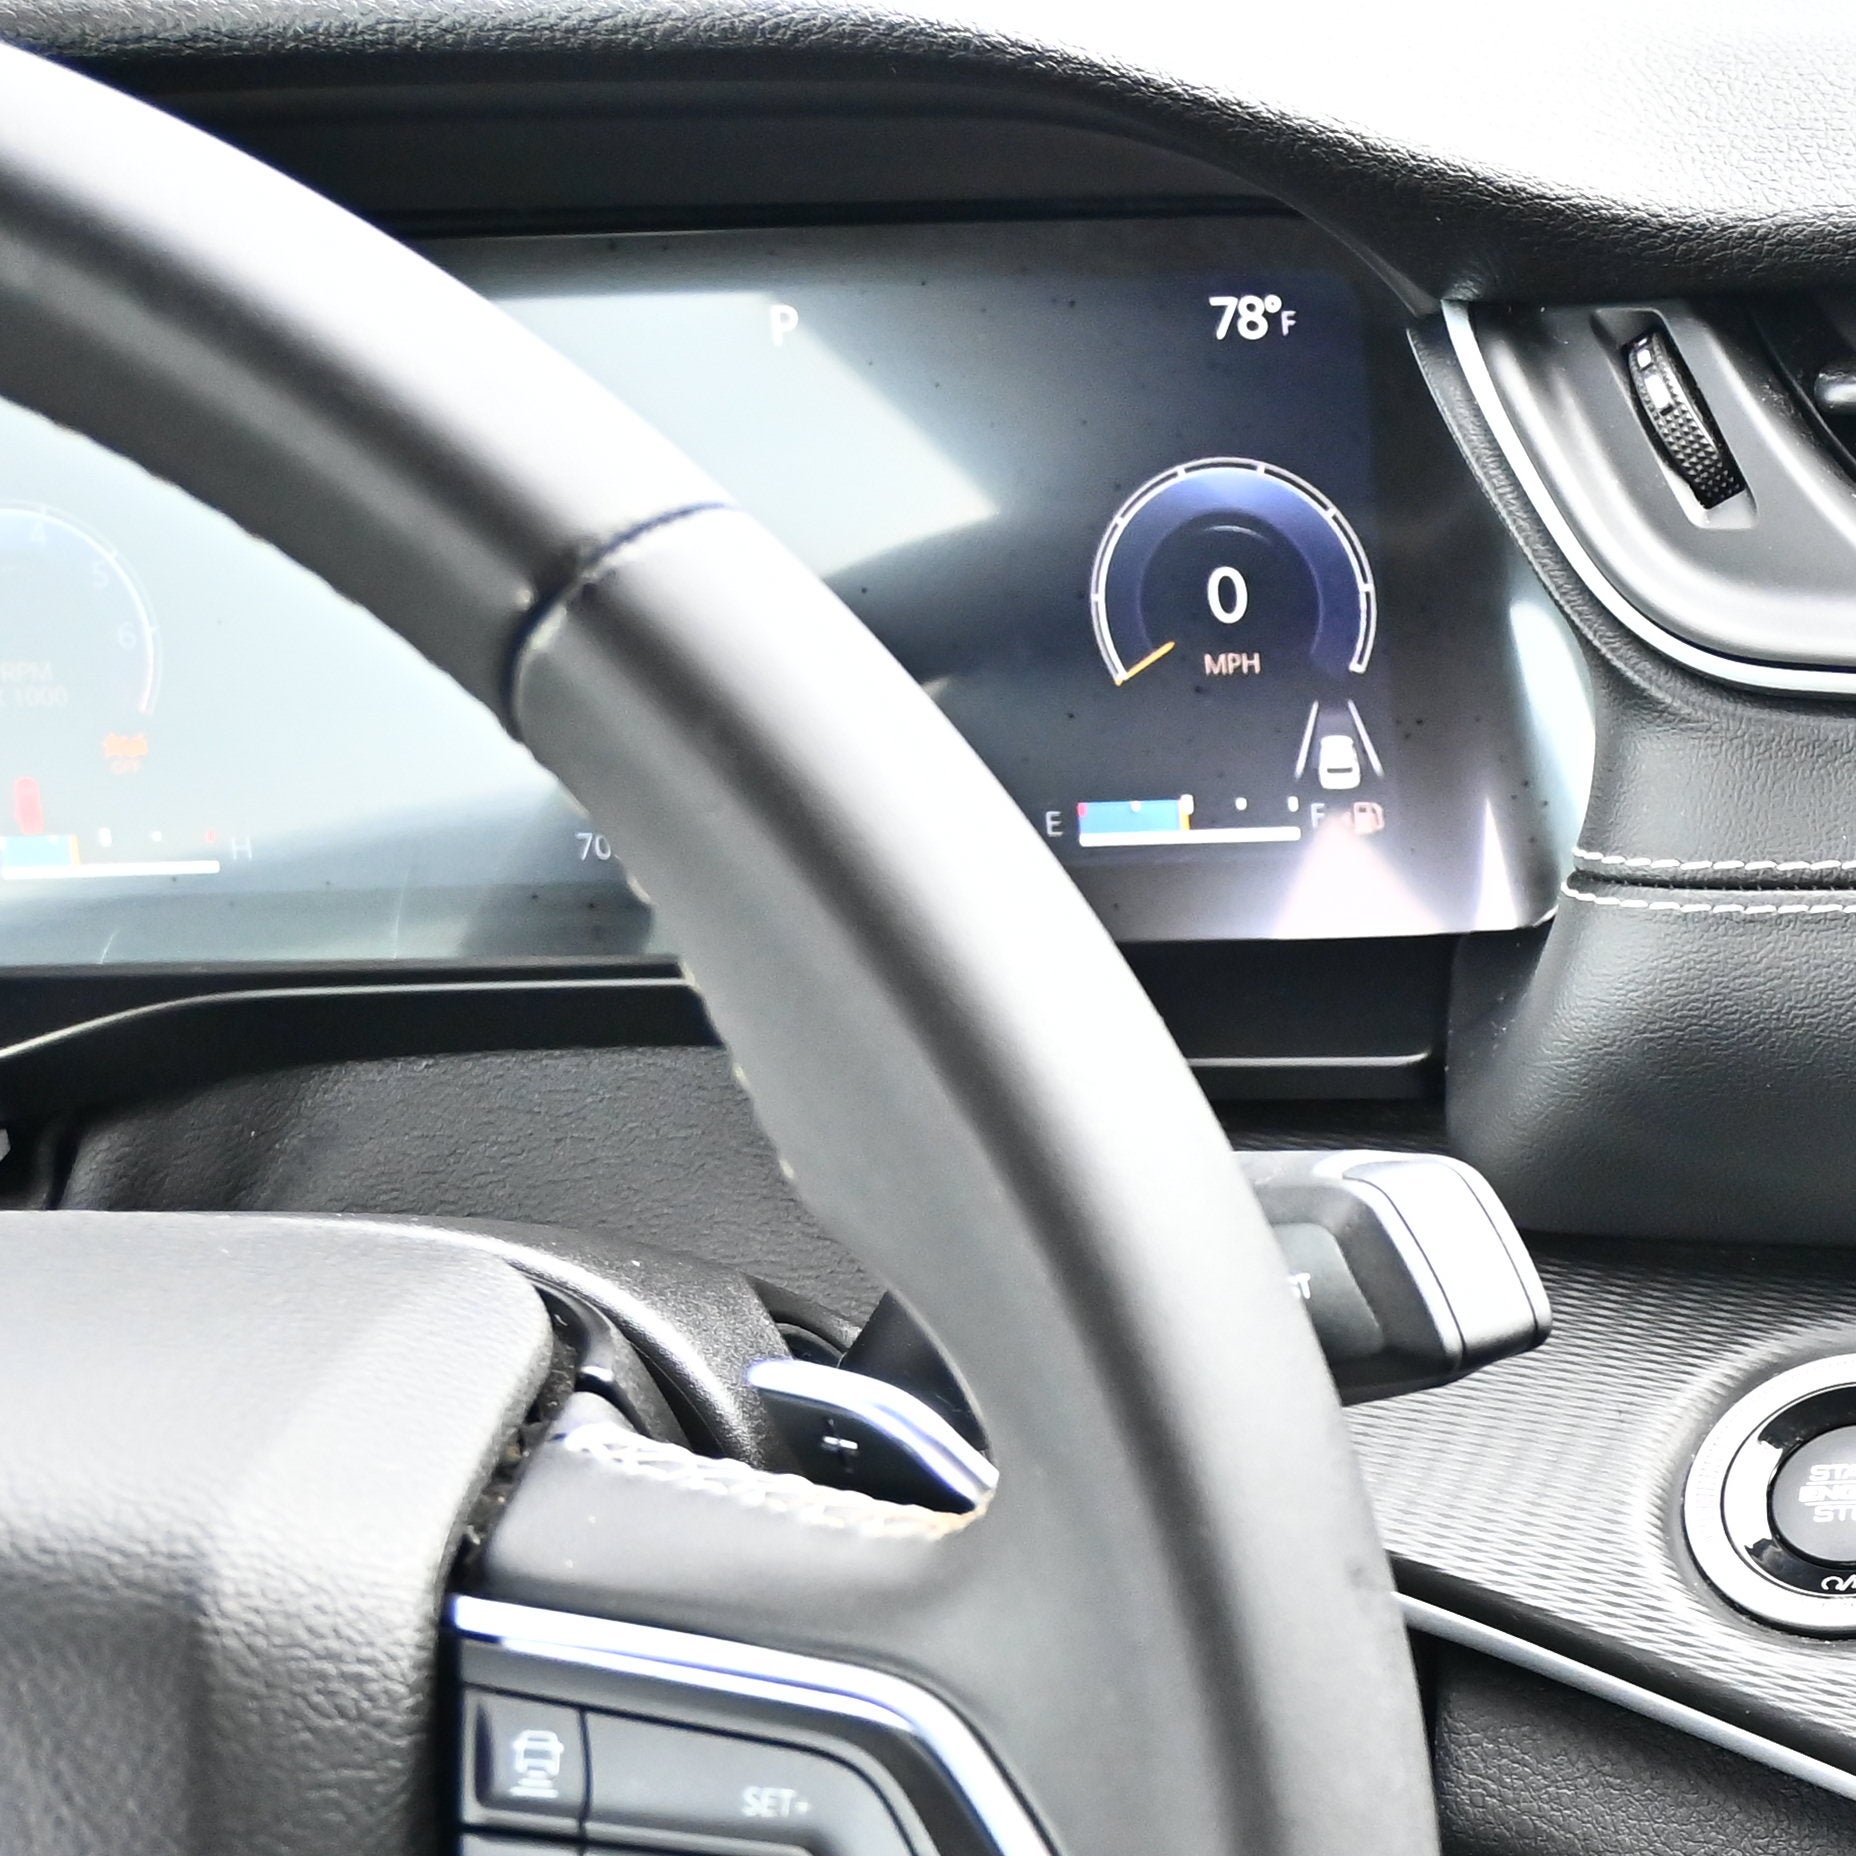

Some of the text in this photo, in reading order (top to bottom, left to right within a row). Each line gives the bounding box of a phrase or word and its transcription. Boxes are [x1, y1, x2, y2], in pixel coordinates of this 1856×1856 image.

[769, 304, 798, 347] P
[1207, 566, 1248, 624] 0
[1205, 652, 1260, 676] MPH
[1046, 811, 1063, 837] E
[1311, 803, 1326, 828] F
[231, 837, 252, 860] H
